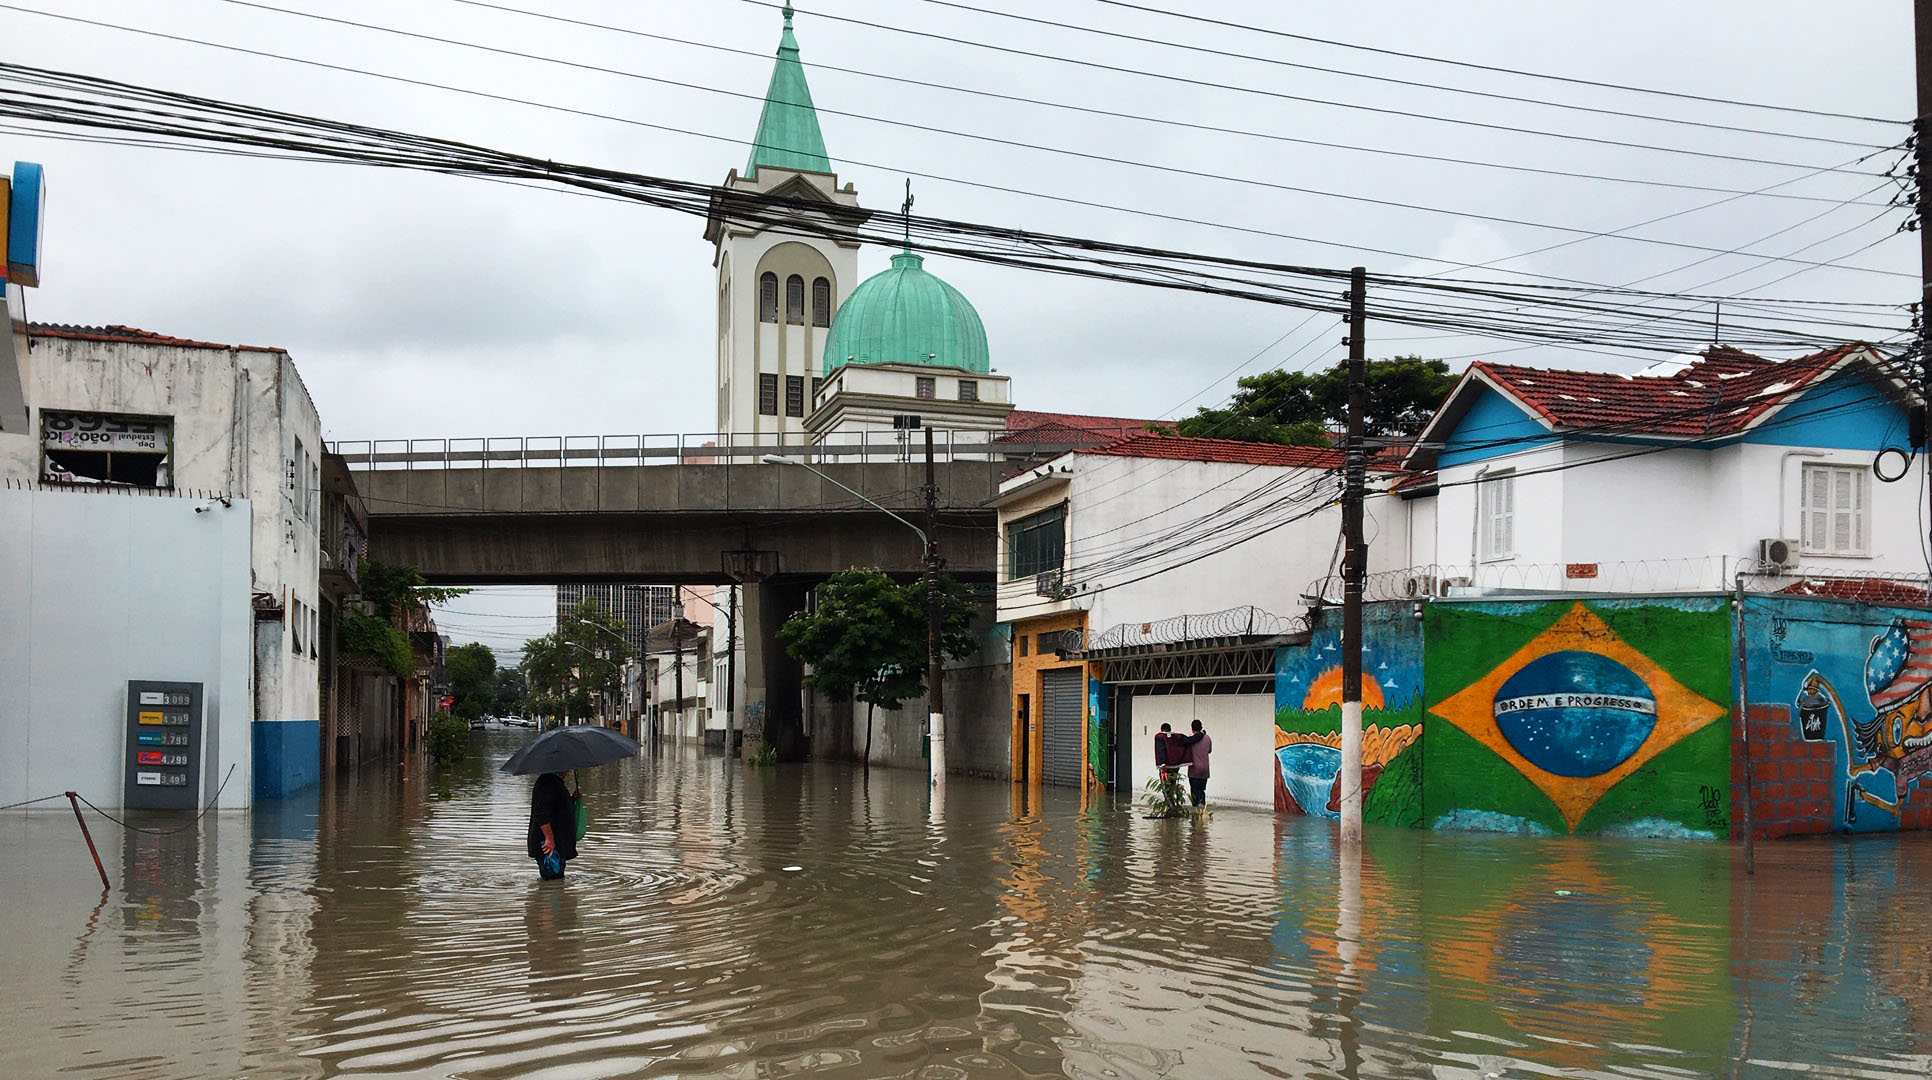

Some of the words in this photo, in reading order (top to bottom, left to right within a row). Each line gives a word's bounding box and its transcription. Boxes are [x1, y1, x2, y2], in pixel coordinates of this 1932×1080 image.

[135, 441, 155, 449] Dep.
[1500, 697, 1549, 711] ORDEM
[1555, 697, 1563, 706] E
[1568, 696, 1642, 709] PROGRESSO
